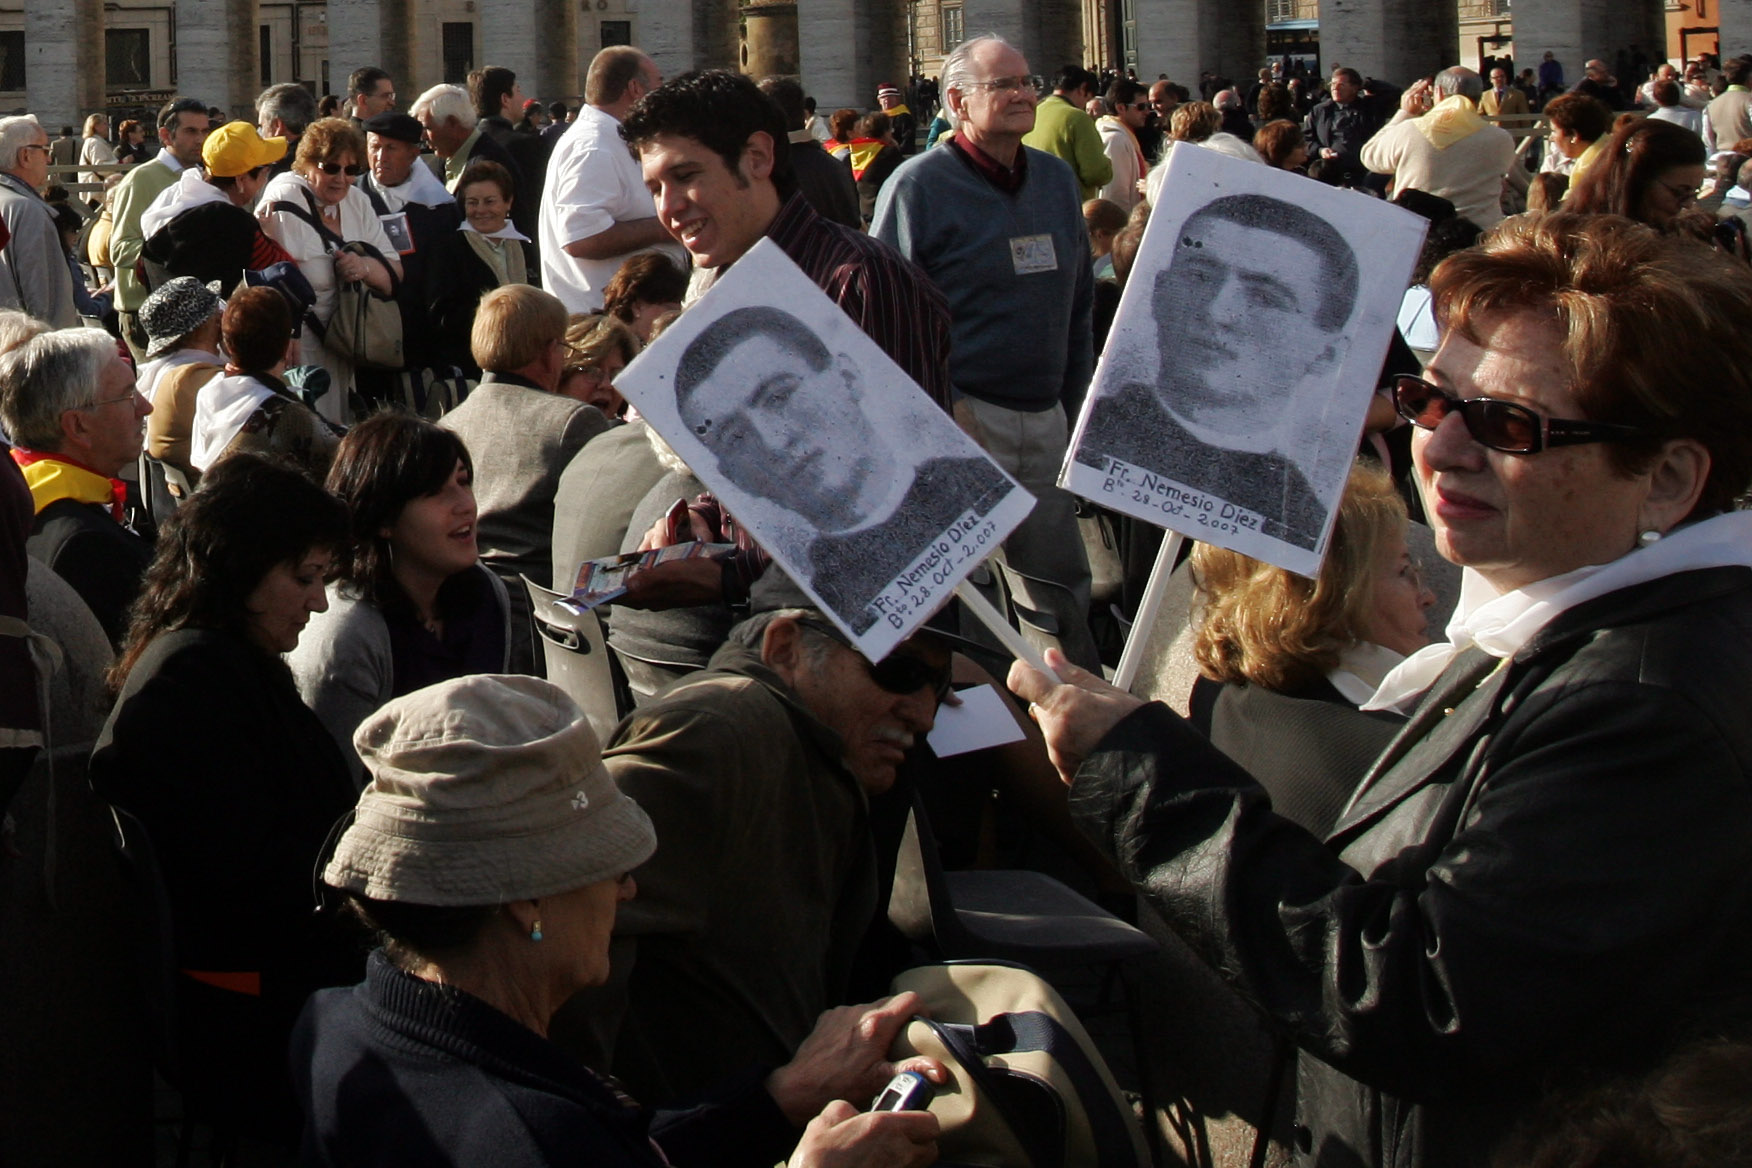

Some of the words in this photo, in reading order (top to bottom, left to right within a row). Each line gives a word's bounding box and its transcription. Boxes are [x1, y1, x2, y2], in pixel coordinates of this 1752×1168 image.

[1108, 461, 1131, 483] Fr.
[1139, 474, 1214, 512] Nemesio
[1219, 503, 1259, 531] Diez
[872, 596, 899, 616] Fr.
[896, 542, 950, 597] Nemesio
[947, 513, 981, 544] Diez
